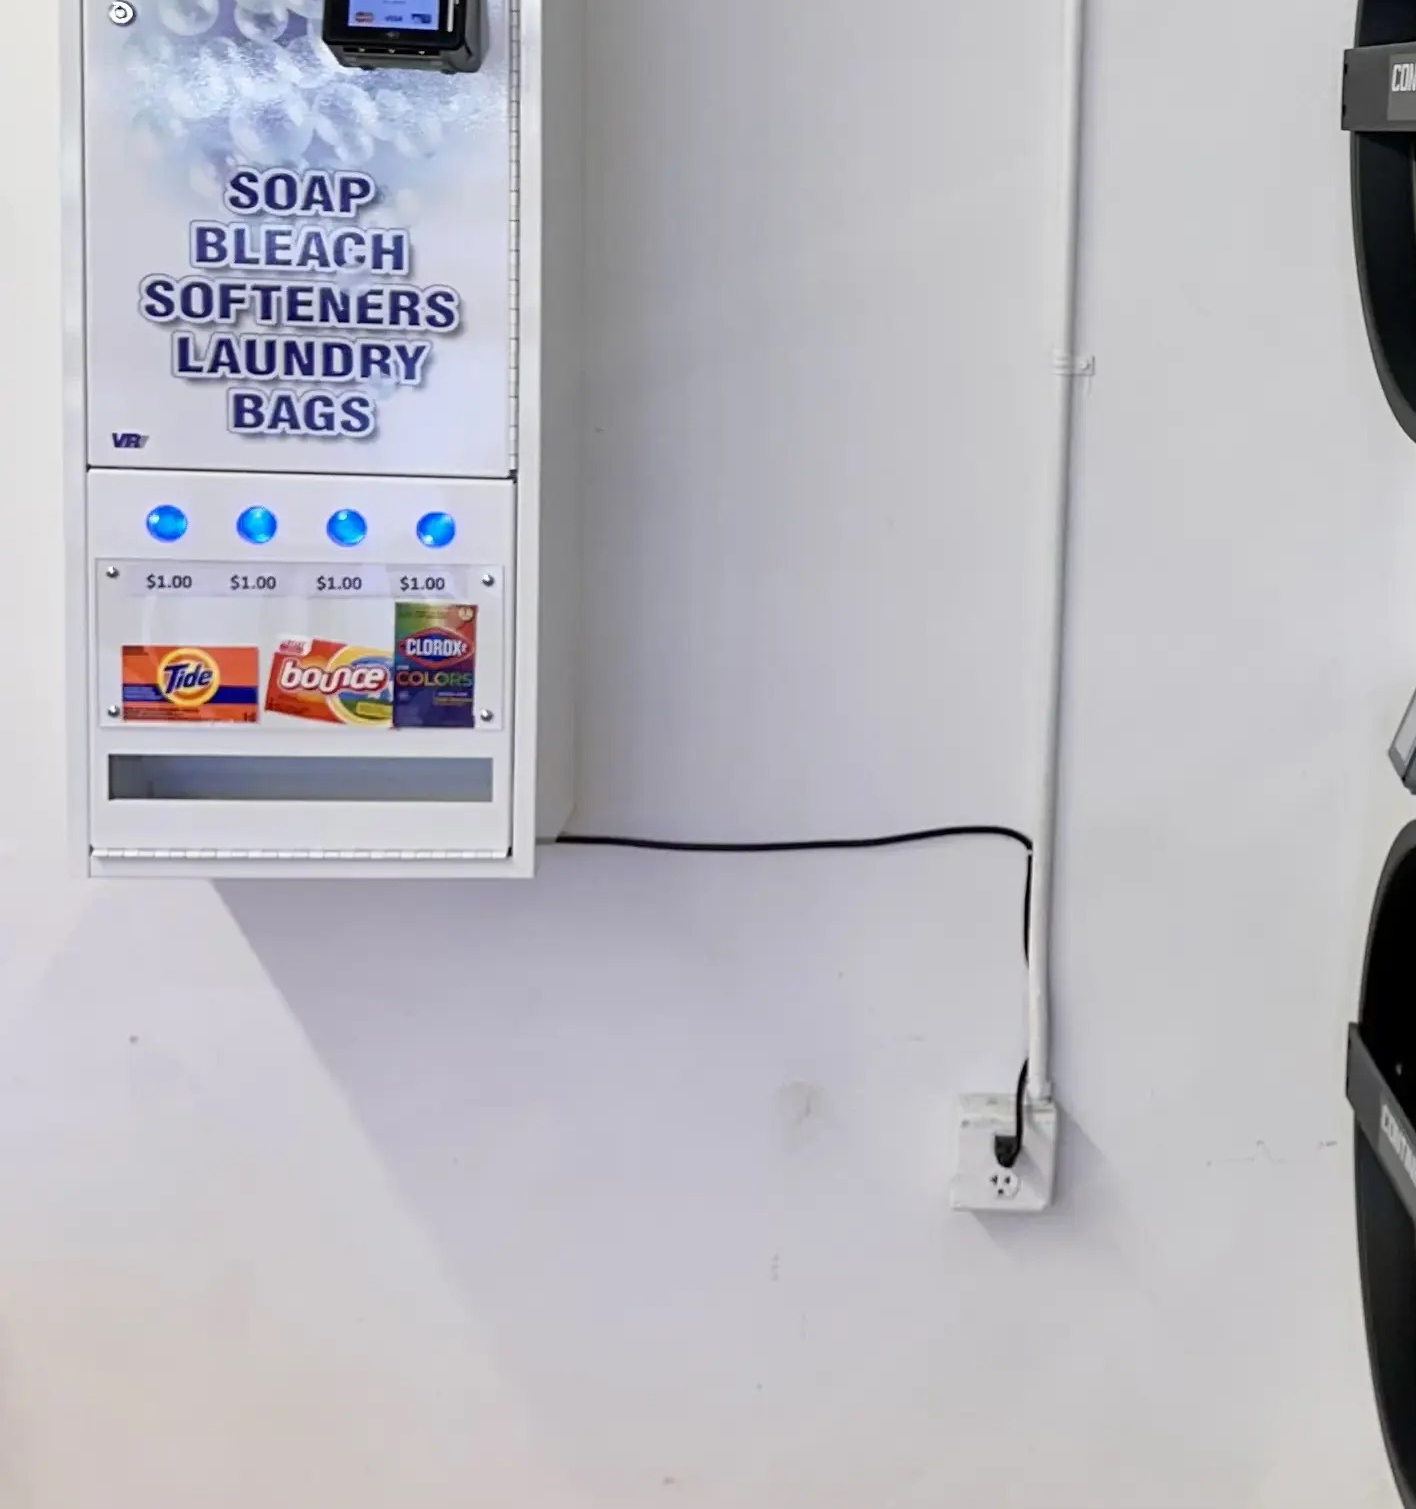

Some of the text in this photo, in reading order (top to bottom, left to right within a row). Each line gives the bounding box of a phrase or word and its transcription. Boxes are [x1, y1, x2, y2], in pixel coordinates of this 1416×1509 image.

[227, 170, 372, 213] SOAP
[195, 225, 406, 272] BLEACH
[143, 278, 456, 328] SOFTENERS
[177, 336, 428, 382] LAUNDRY
[232, 392, 371, 433] BAGS
[146, 573, 193, 590] $1.00
[229, 574, 277, 591] $1.00
[316, 575, 363, 592] $1.00
[399, 575, 446, 593] $1.00
[163, 662, 214, 694] Tide
[280, 658, 387, 692] bounce
[396, 671, 474, 688] COLORS
